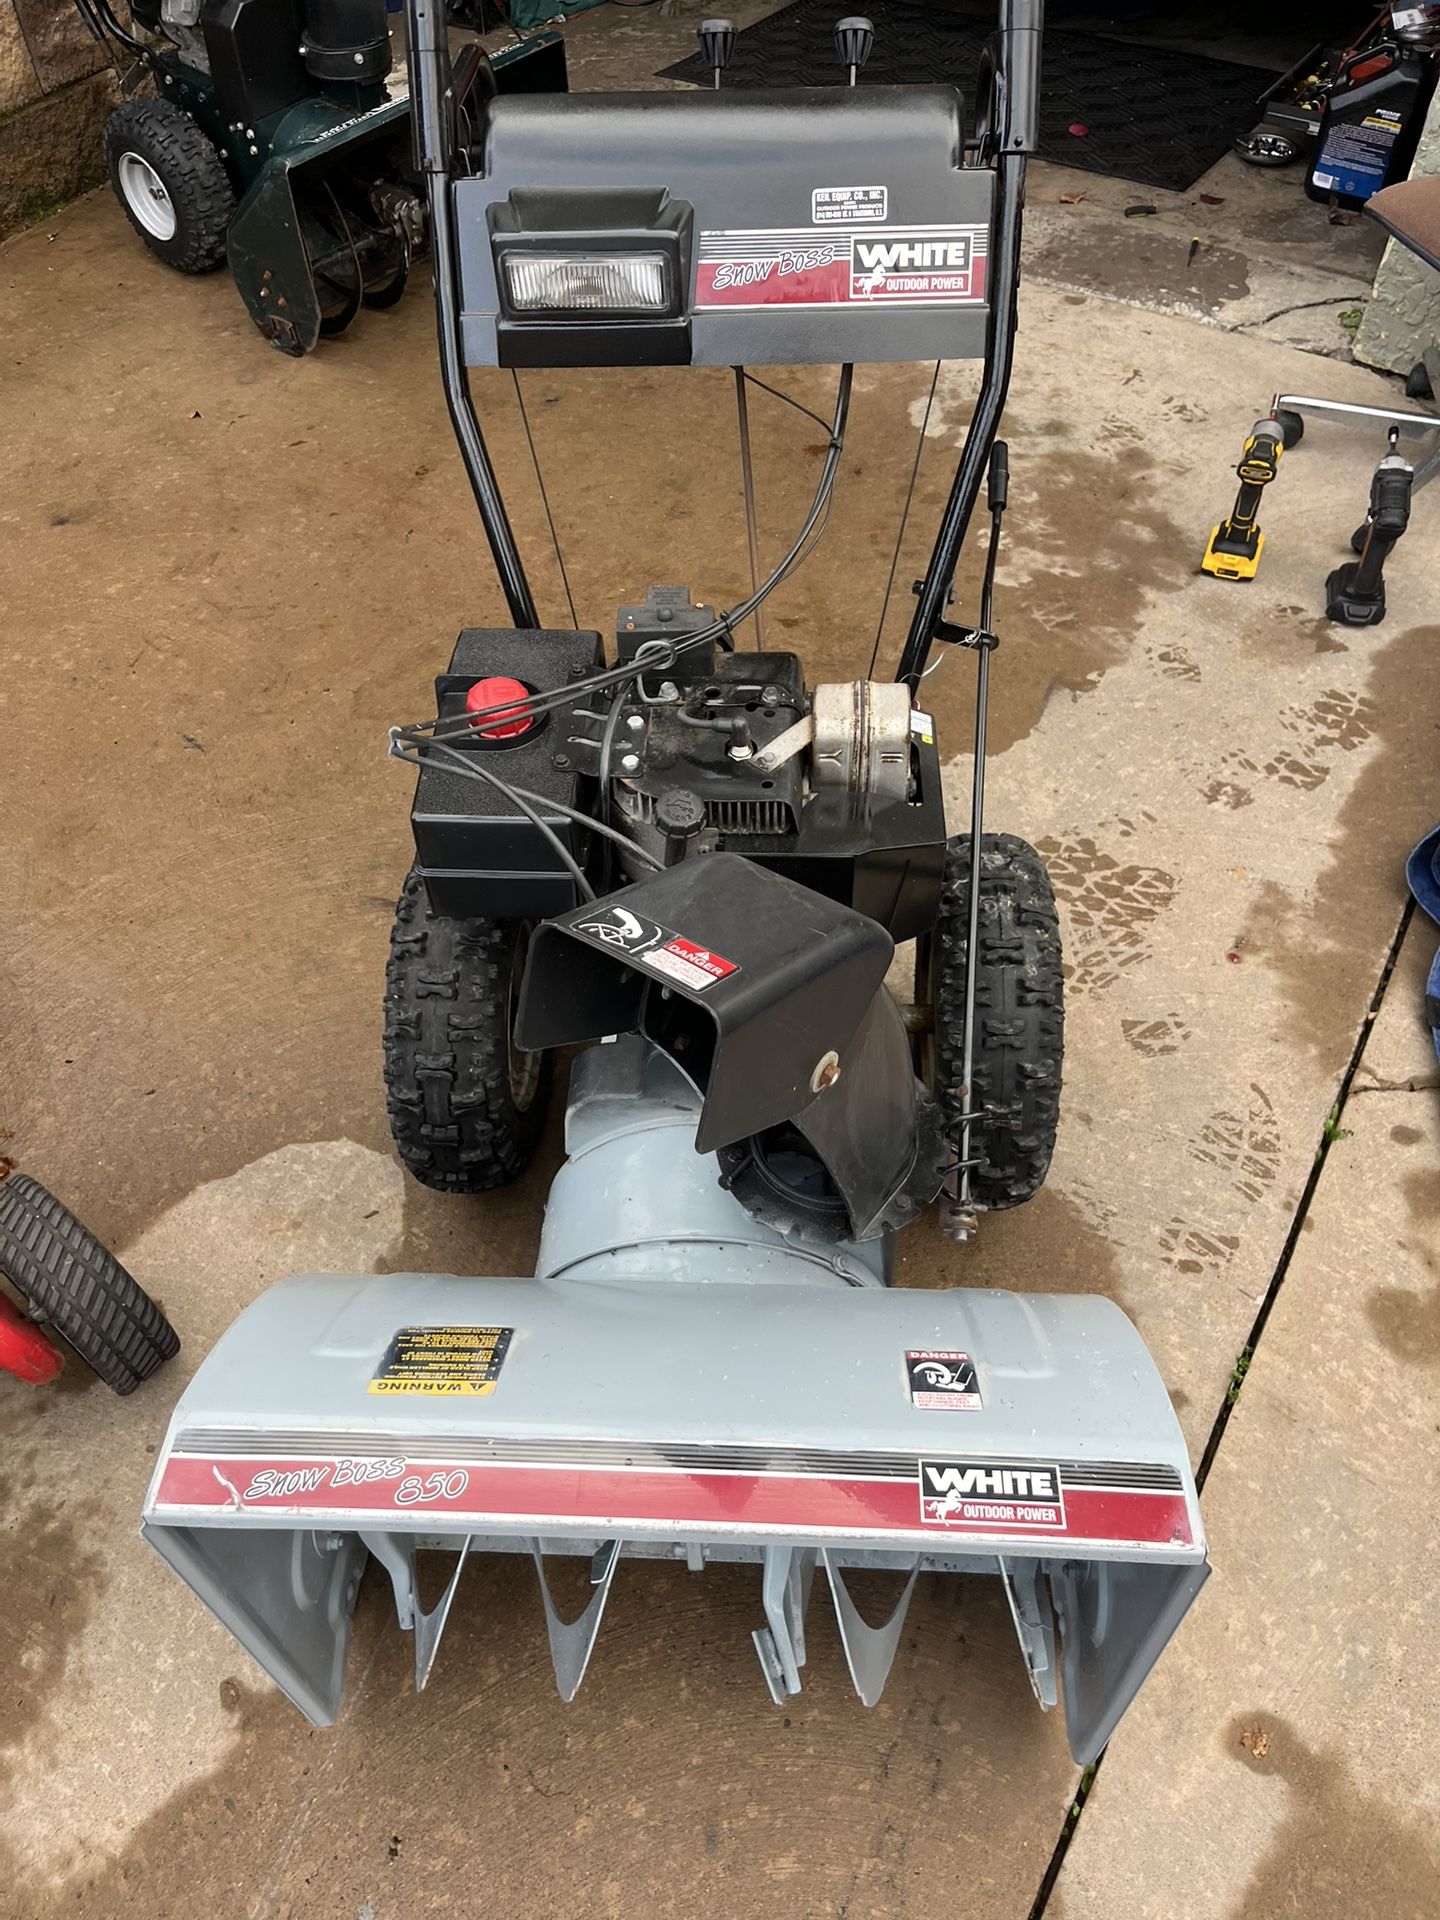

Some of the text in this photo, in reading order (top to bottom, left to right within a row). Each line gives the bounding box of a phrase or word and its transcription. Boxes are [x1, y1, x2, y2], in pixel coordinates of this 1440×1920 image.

[855, 241, 966, 268] WHITE
[886, 276, 964, 291] OUTDOOR POWER
[667, 944, 724, 976] DANGER
[910, 1351, 969, 1360] DANGER
[376, 1382, 462, 1391] WARNING
[394, 1469, 470, 1506] 850
[925, 1466, 1055, 1496] WHITE
[963, 1503, 1057, 1522] OUTDOOR POWER
